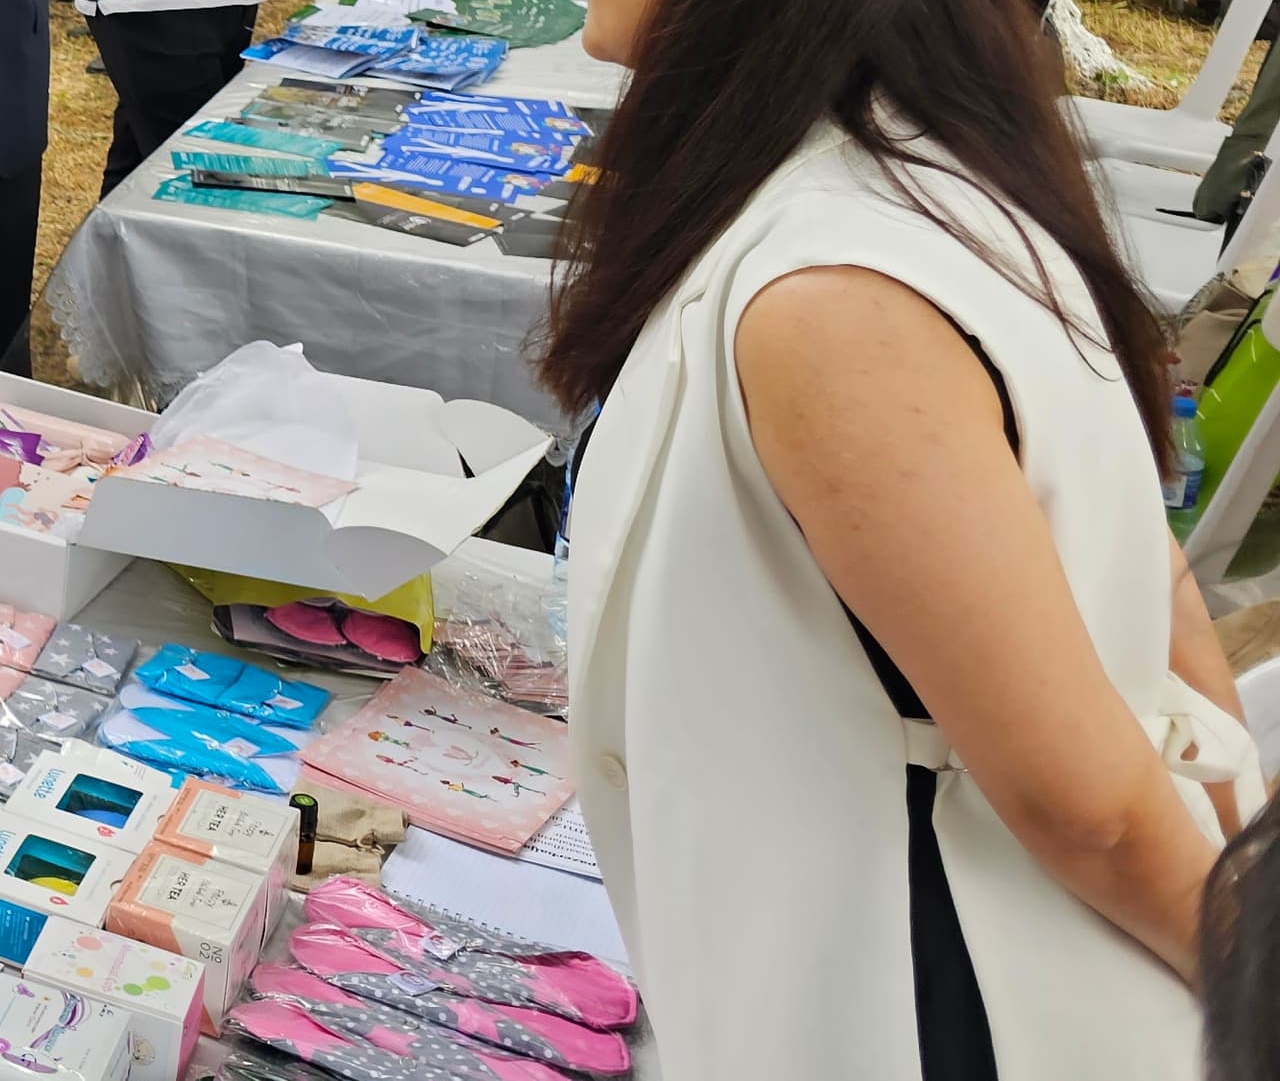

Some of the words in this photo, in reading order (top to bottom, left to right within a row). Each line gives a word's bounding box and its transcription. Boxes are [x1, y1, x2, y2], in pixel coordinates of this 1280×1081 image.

[207, 816, 221, 832] TEA
[168, 887, 183, 901] TEA
[199, 941, 211, 960] 02
